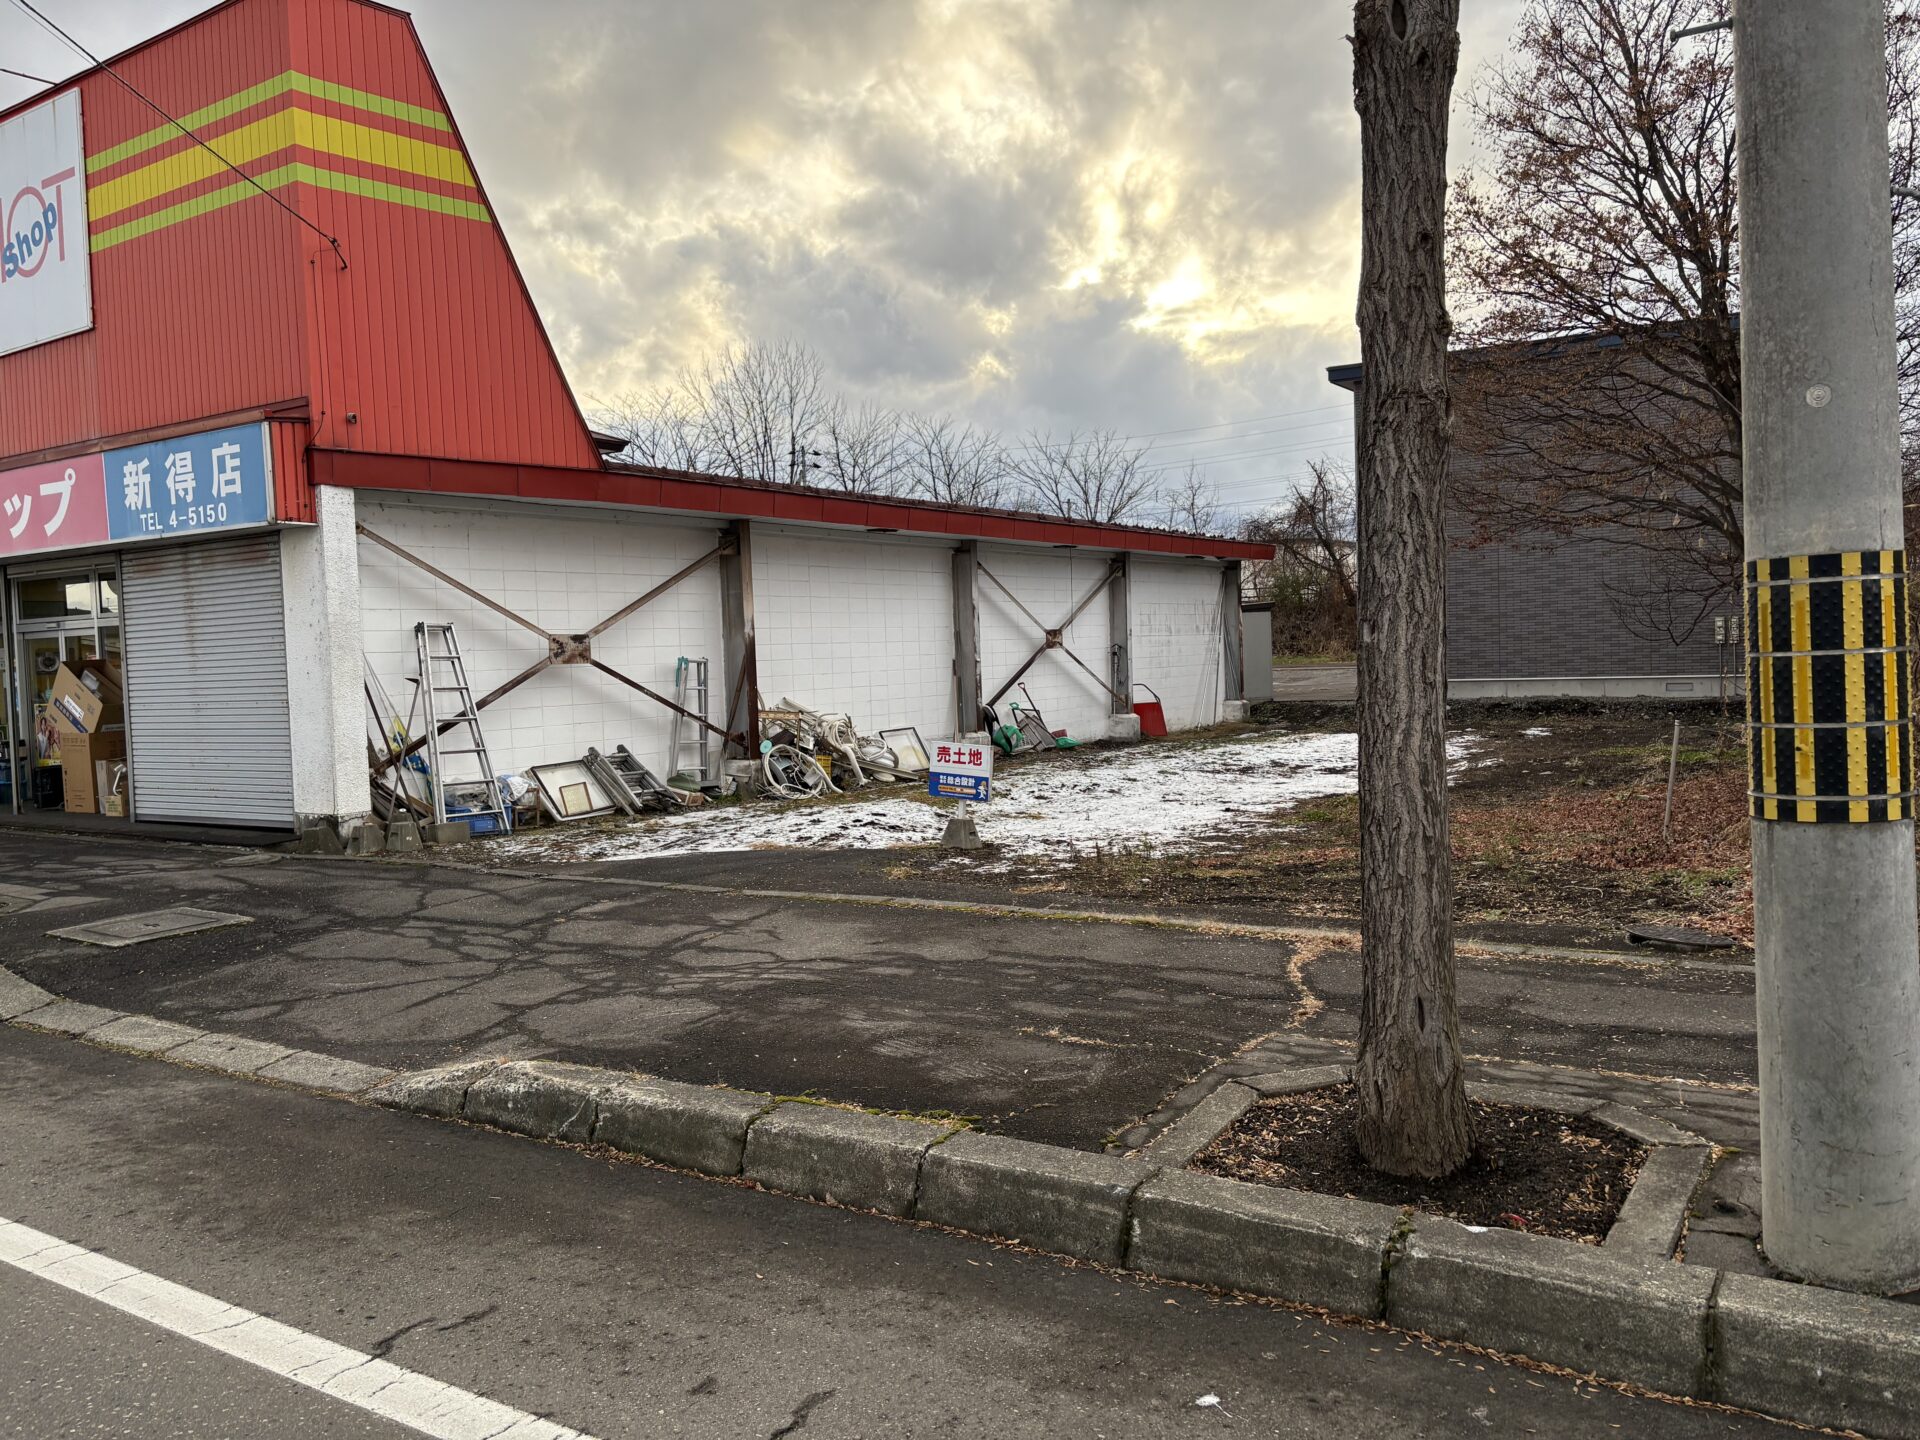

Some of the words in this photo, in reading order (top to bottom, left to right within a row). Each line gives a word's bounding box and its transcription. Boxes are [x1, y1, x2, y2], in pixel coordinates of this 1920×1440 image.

[123, 442, 242, 511] 新得店
[140, 512, 163, 532] TEL
[169, 502, 227, 528] 4-5150
[937, 746, 982, 766] 売土地
